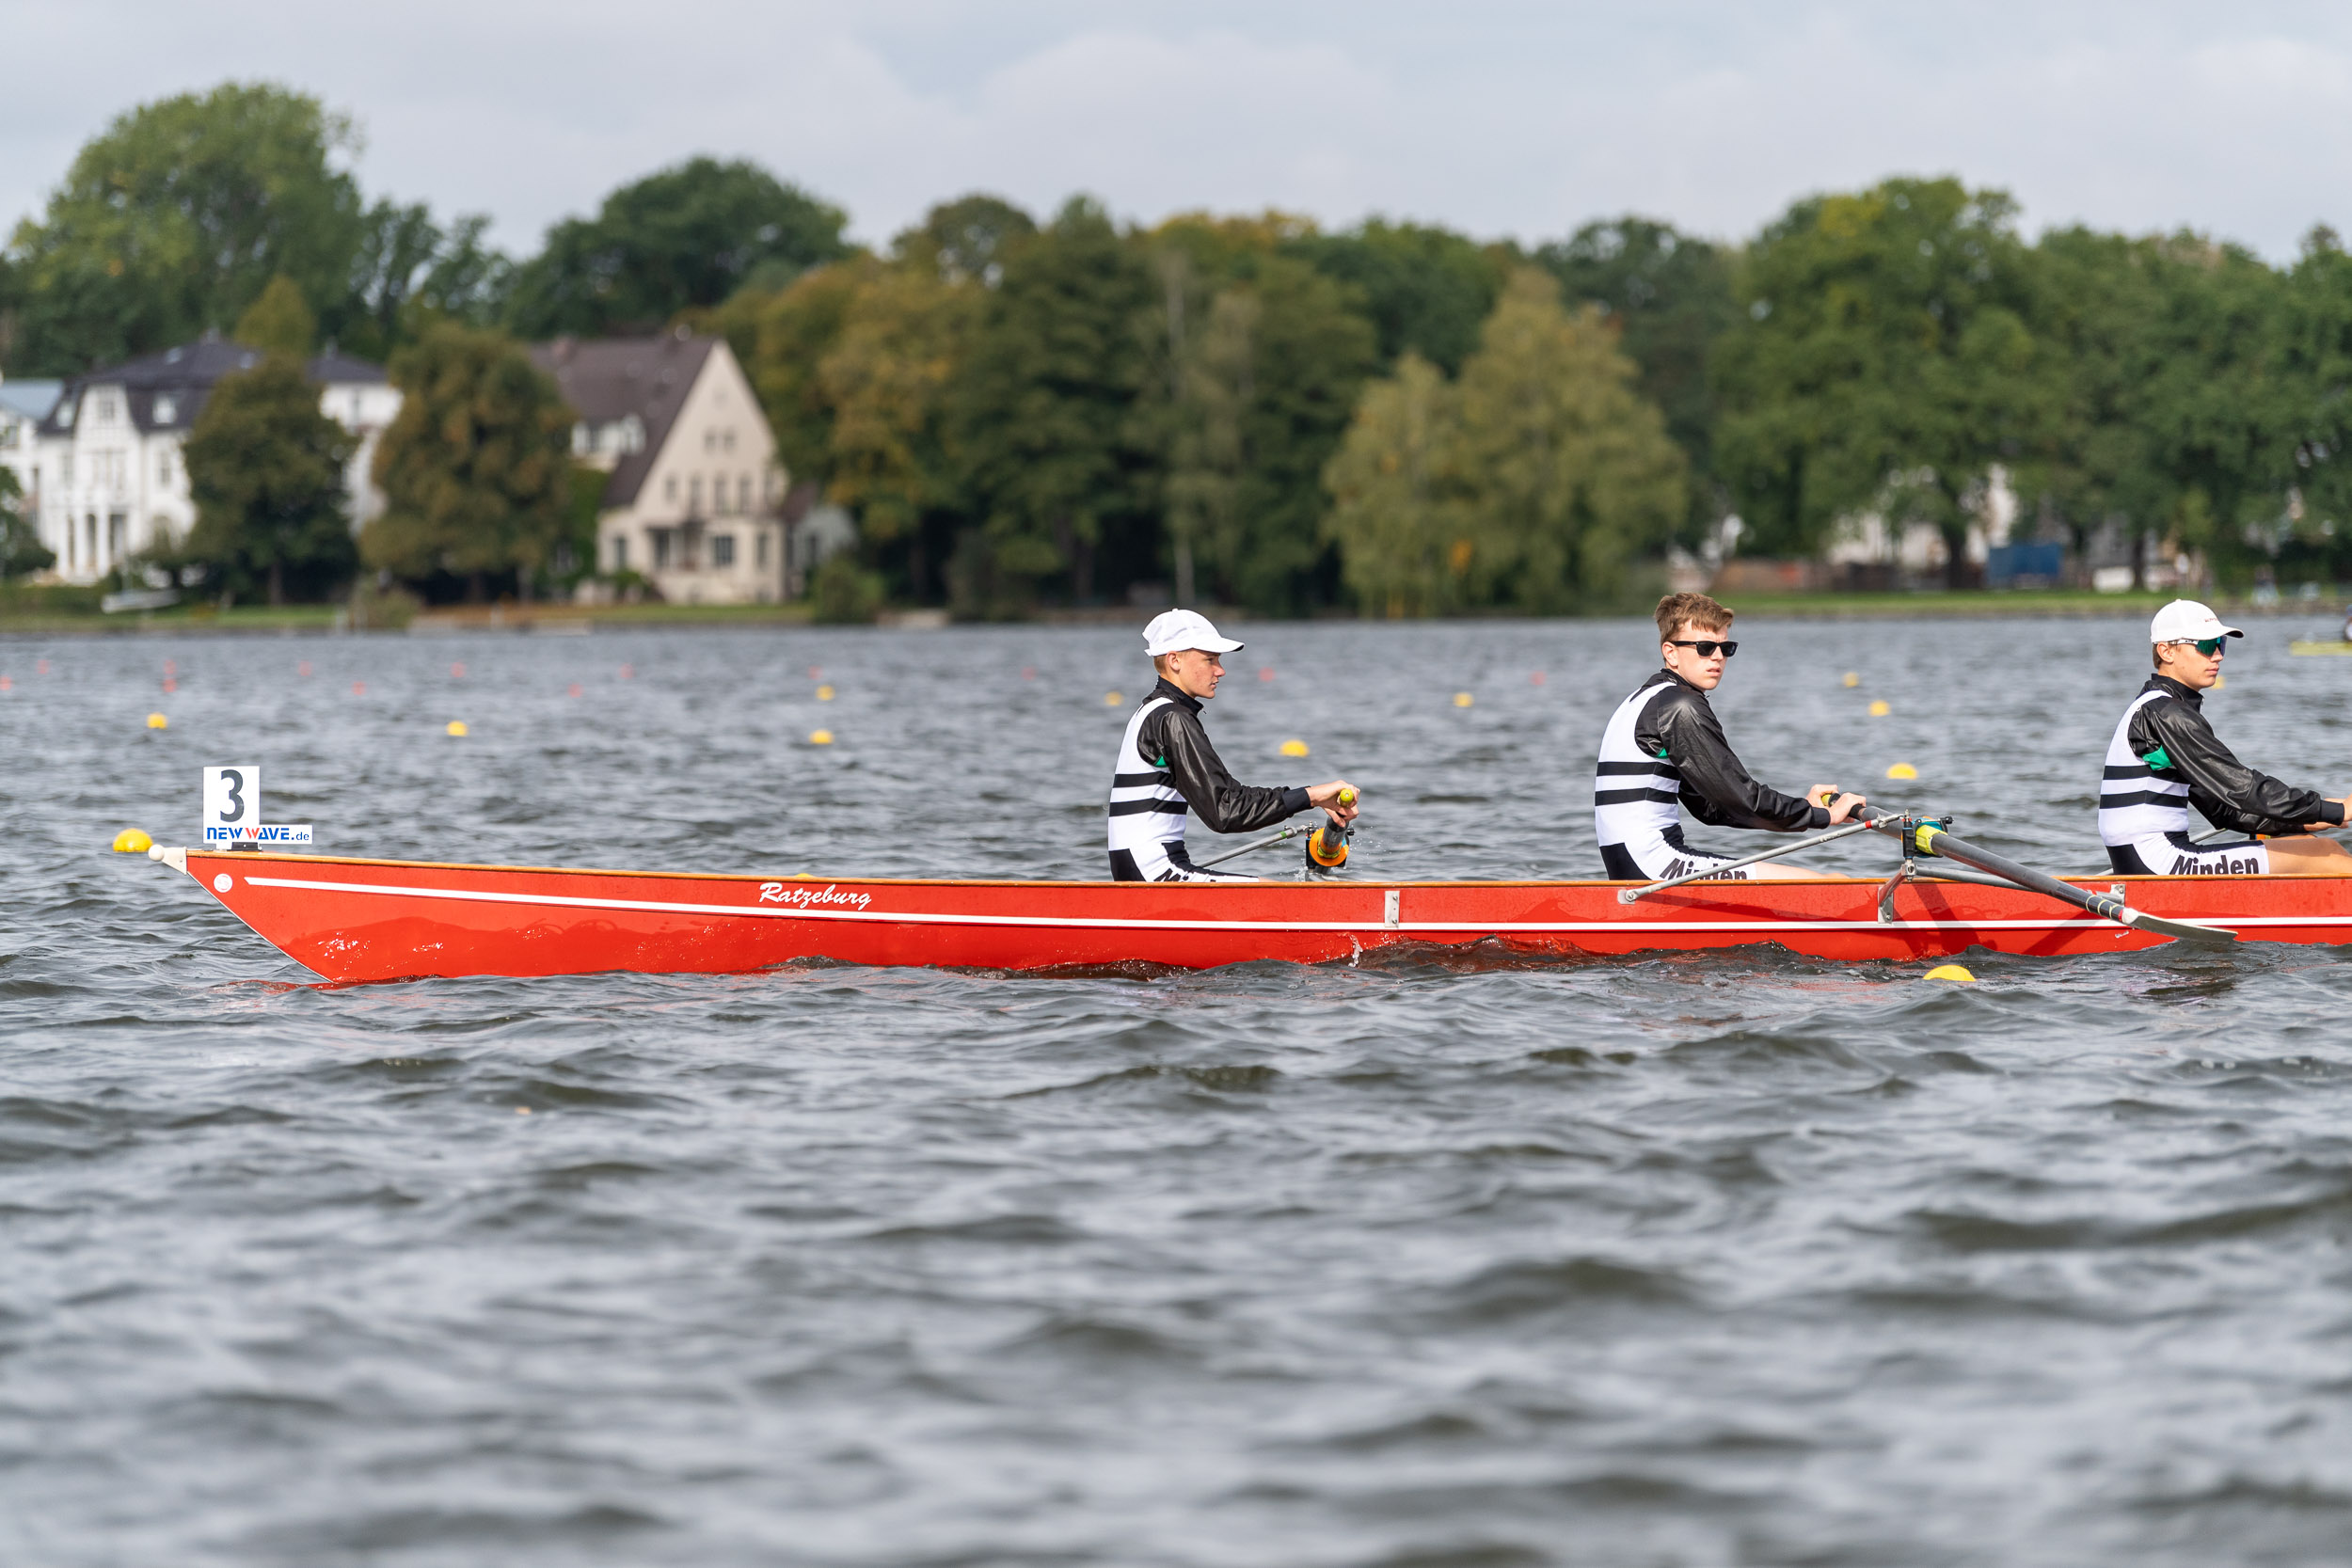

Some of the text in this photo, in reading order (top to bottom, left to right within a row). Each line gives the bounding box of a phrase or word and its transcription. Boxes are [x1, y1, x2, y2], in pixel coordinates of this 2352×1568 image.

[219, 768, 245, 823] 3
[1659, 857, 1748, 880] Mien
[2169, 854, 2260, 875] Minden
[758, 881, 873, 911] Ratzeburg
